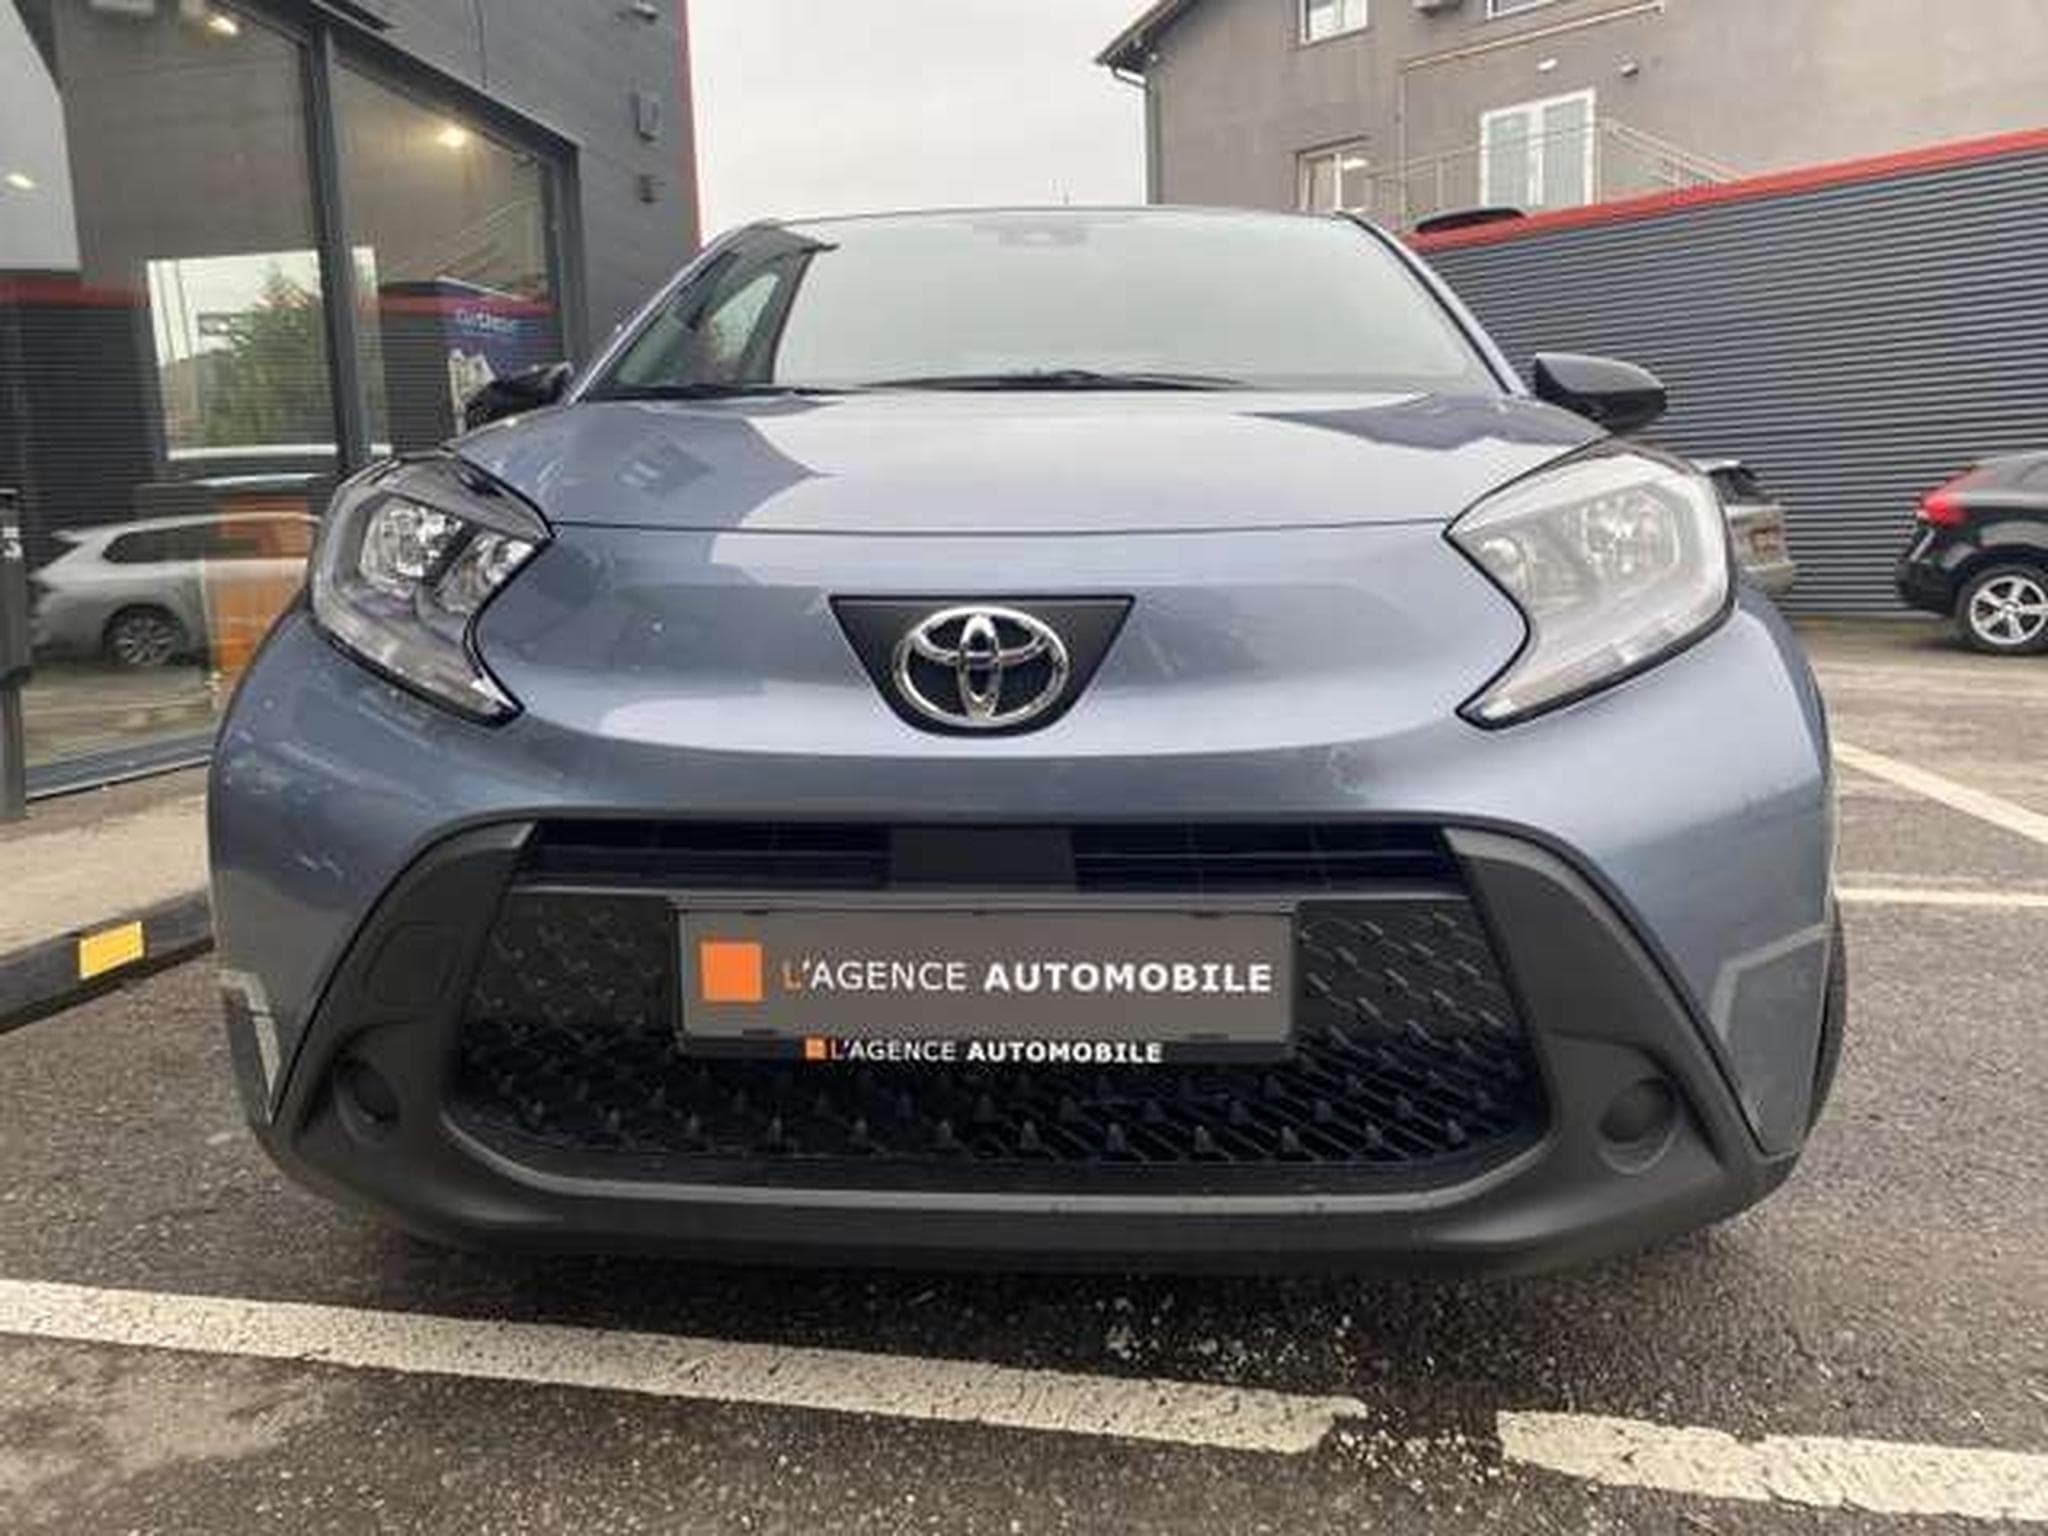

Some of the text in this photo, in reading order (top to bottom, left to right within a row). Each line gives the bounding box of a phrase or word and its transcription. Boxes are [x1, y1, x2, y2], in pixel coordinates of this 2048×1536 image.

[781, 960, 1273, 993] L'AGENCE AUTOMOBILE
[830, 1037, 1164, 1064] L'AGENCE AUTOMOBILE
